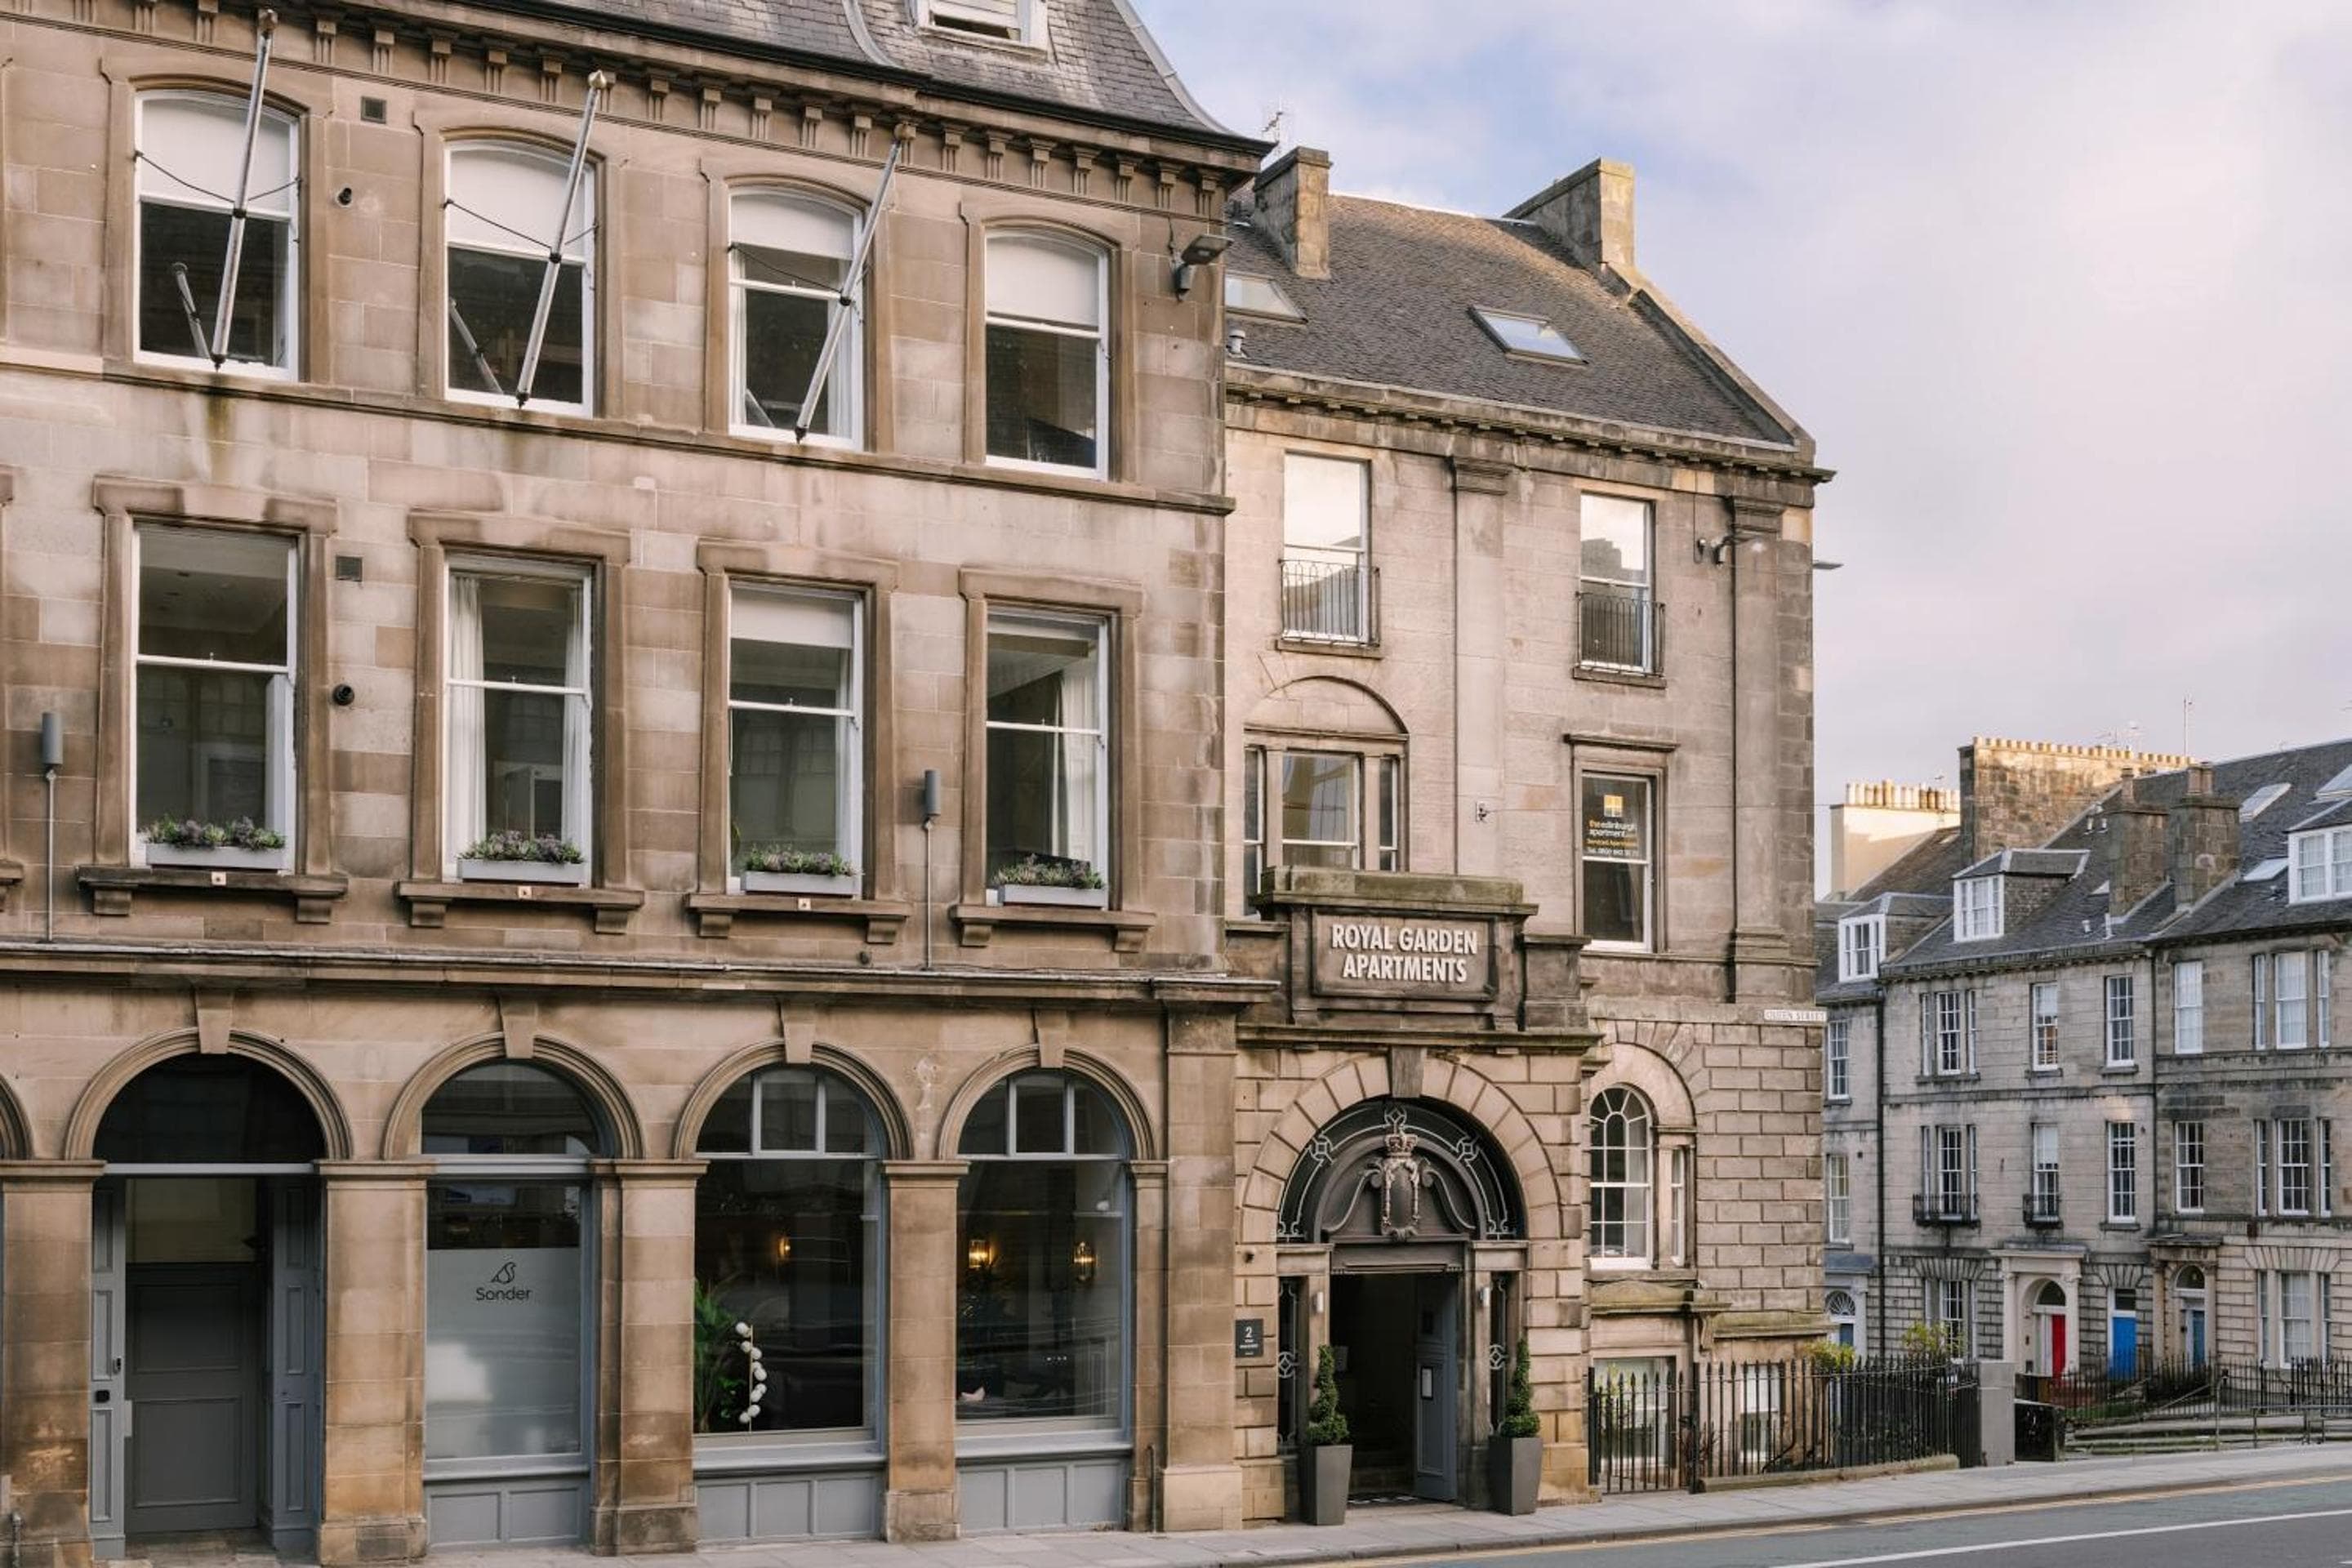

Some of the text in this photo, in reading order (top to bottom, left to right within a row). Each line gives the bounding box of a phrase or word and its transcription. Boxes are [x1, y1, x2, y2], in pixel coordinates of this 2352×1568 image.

[1331, 924, 1477, 955] ROYAL GARDEN
[1342, 954, 1468, 982] APARTMENTS
[476, 1286, 533, 1301] Sonder
[1245, 1325, 1253, 1338] 2
